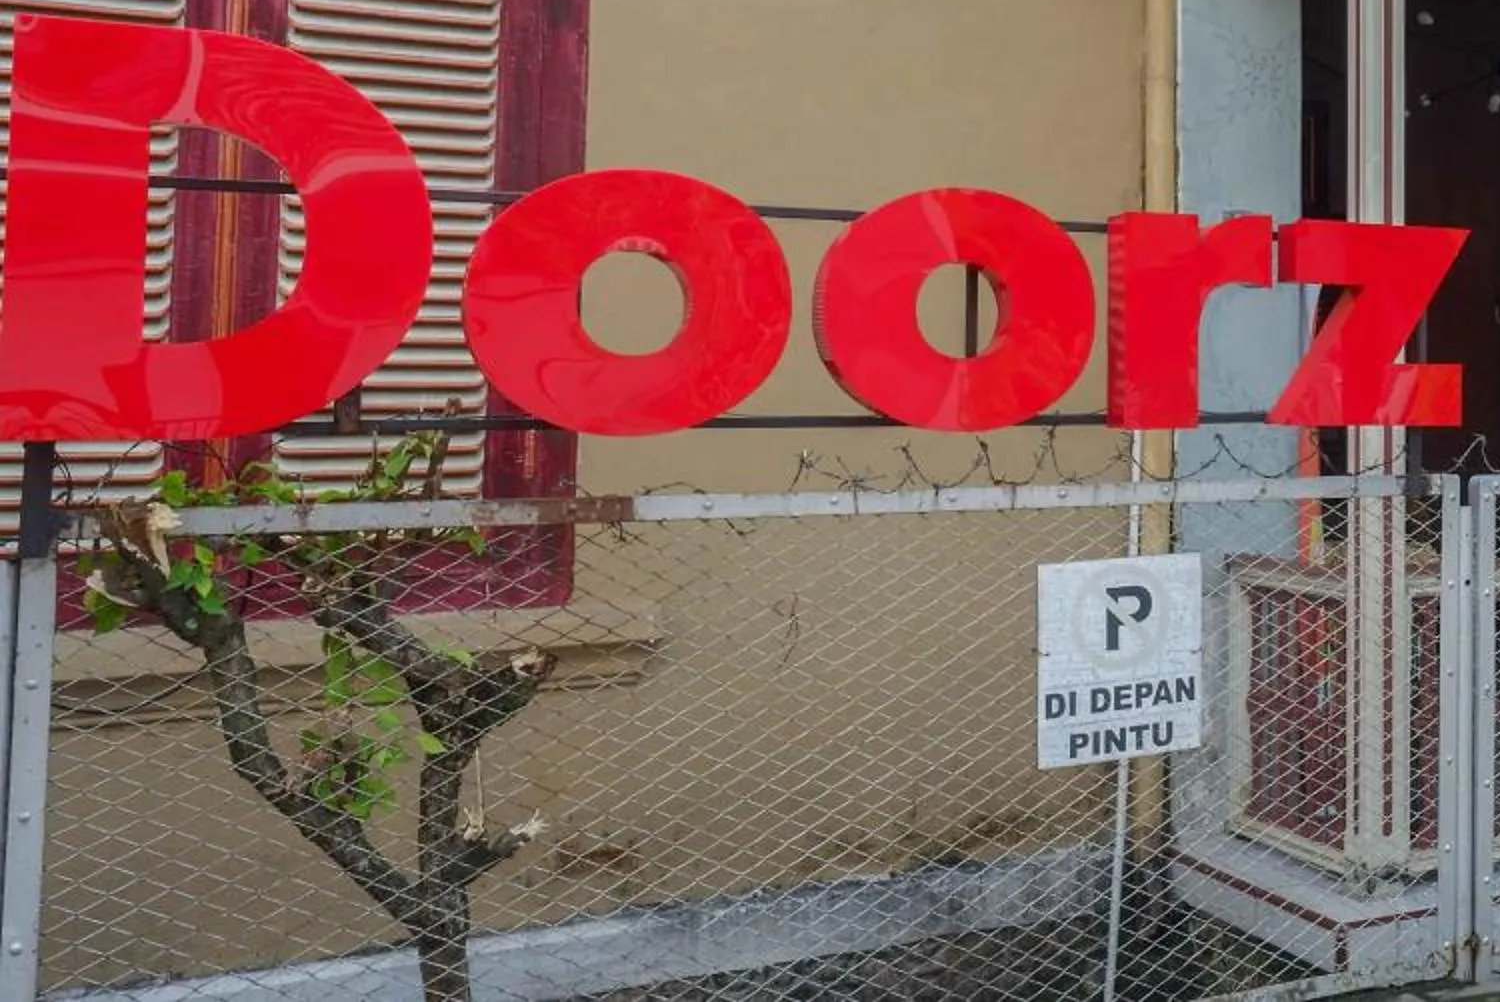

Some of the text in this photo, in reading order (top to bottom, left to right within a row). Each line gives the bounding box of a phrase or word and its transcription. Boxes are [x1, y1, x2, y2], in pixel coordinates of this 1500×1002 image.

[0, 12, 1472, 441] Doorz
[1105, 585, 1153, 651] P
[1045, 675, 1196, 720] DI DEPAN
[1068, 720, 1174, 759] PINTU
